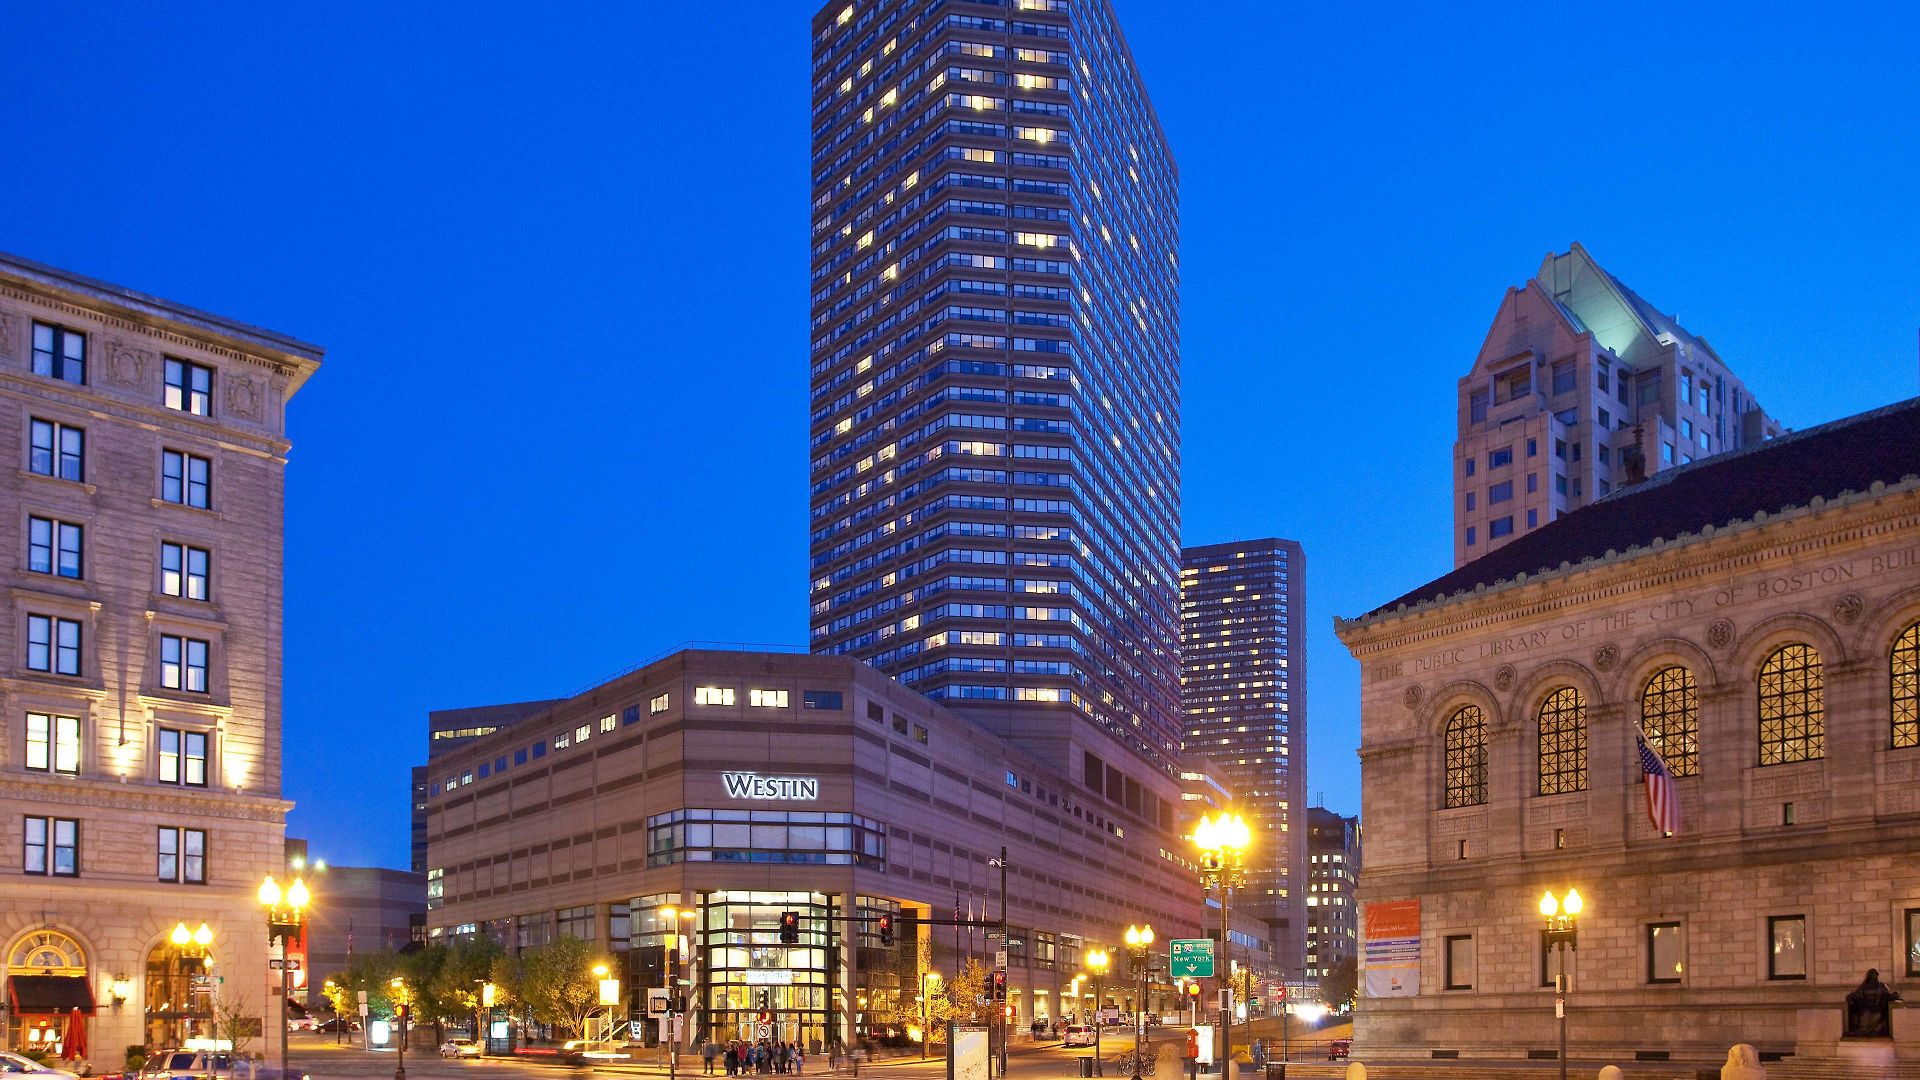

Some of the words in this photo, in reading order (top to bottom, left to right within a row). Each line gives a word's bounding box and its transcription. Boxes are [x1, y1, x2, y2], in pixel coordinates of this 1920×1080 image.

[1376, 663, 1404, 680] THE
[1415, 649, 1465, 672] PUBLIC
[1480, 630, 1550, 657] LIBRARY
[1561, 621, 1586, 640] OF
[1601, 610, 1637, 631] THE
[1649, 598, 1697, 621] CITY
[1714, 586, 1744, 607] OF
[1757, 564, 1854, 598] BOSTON
